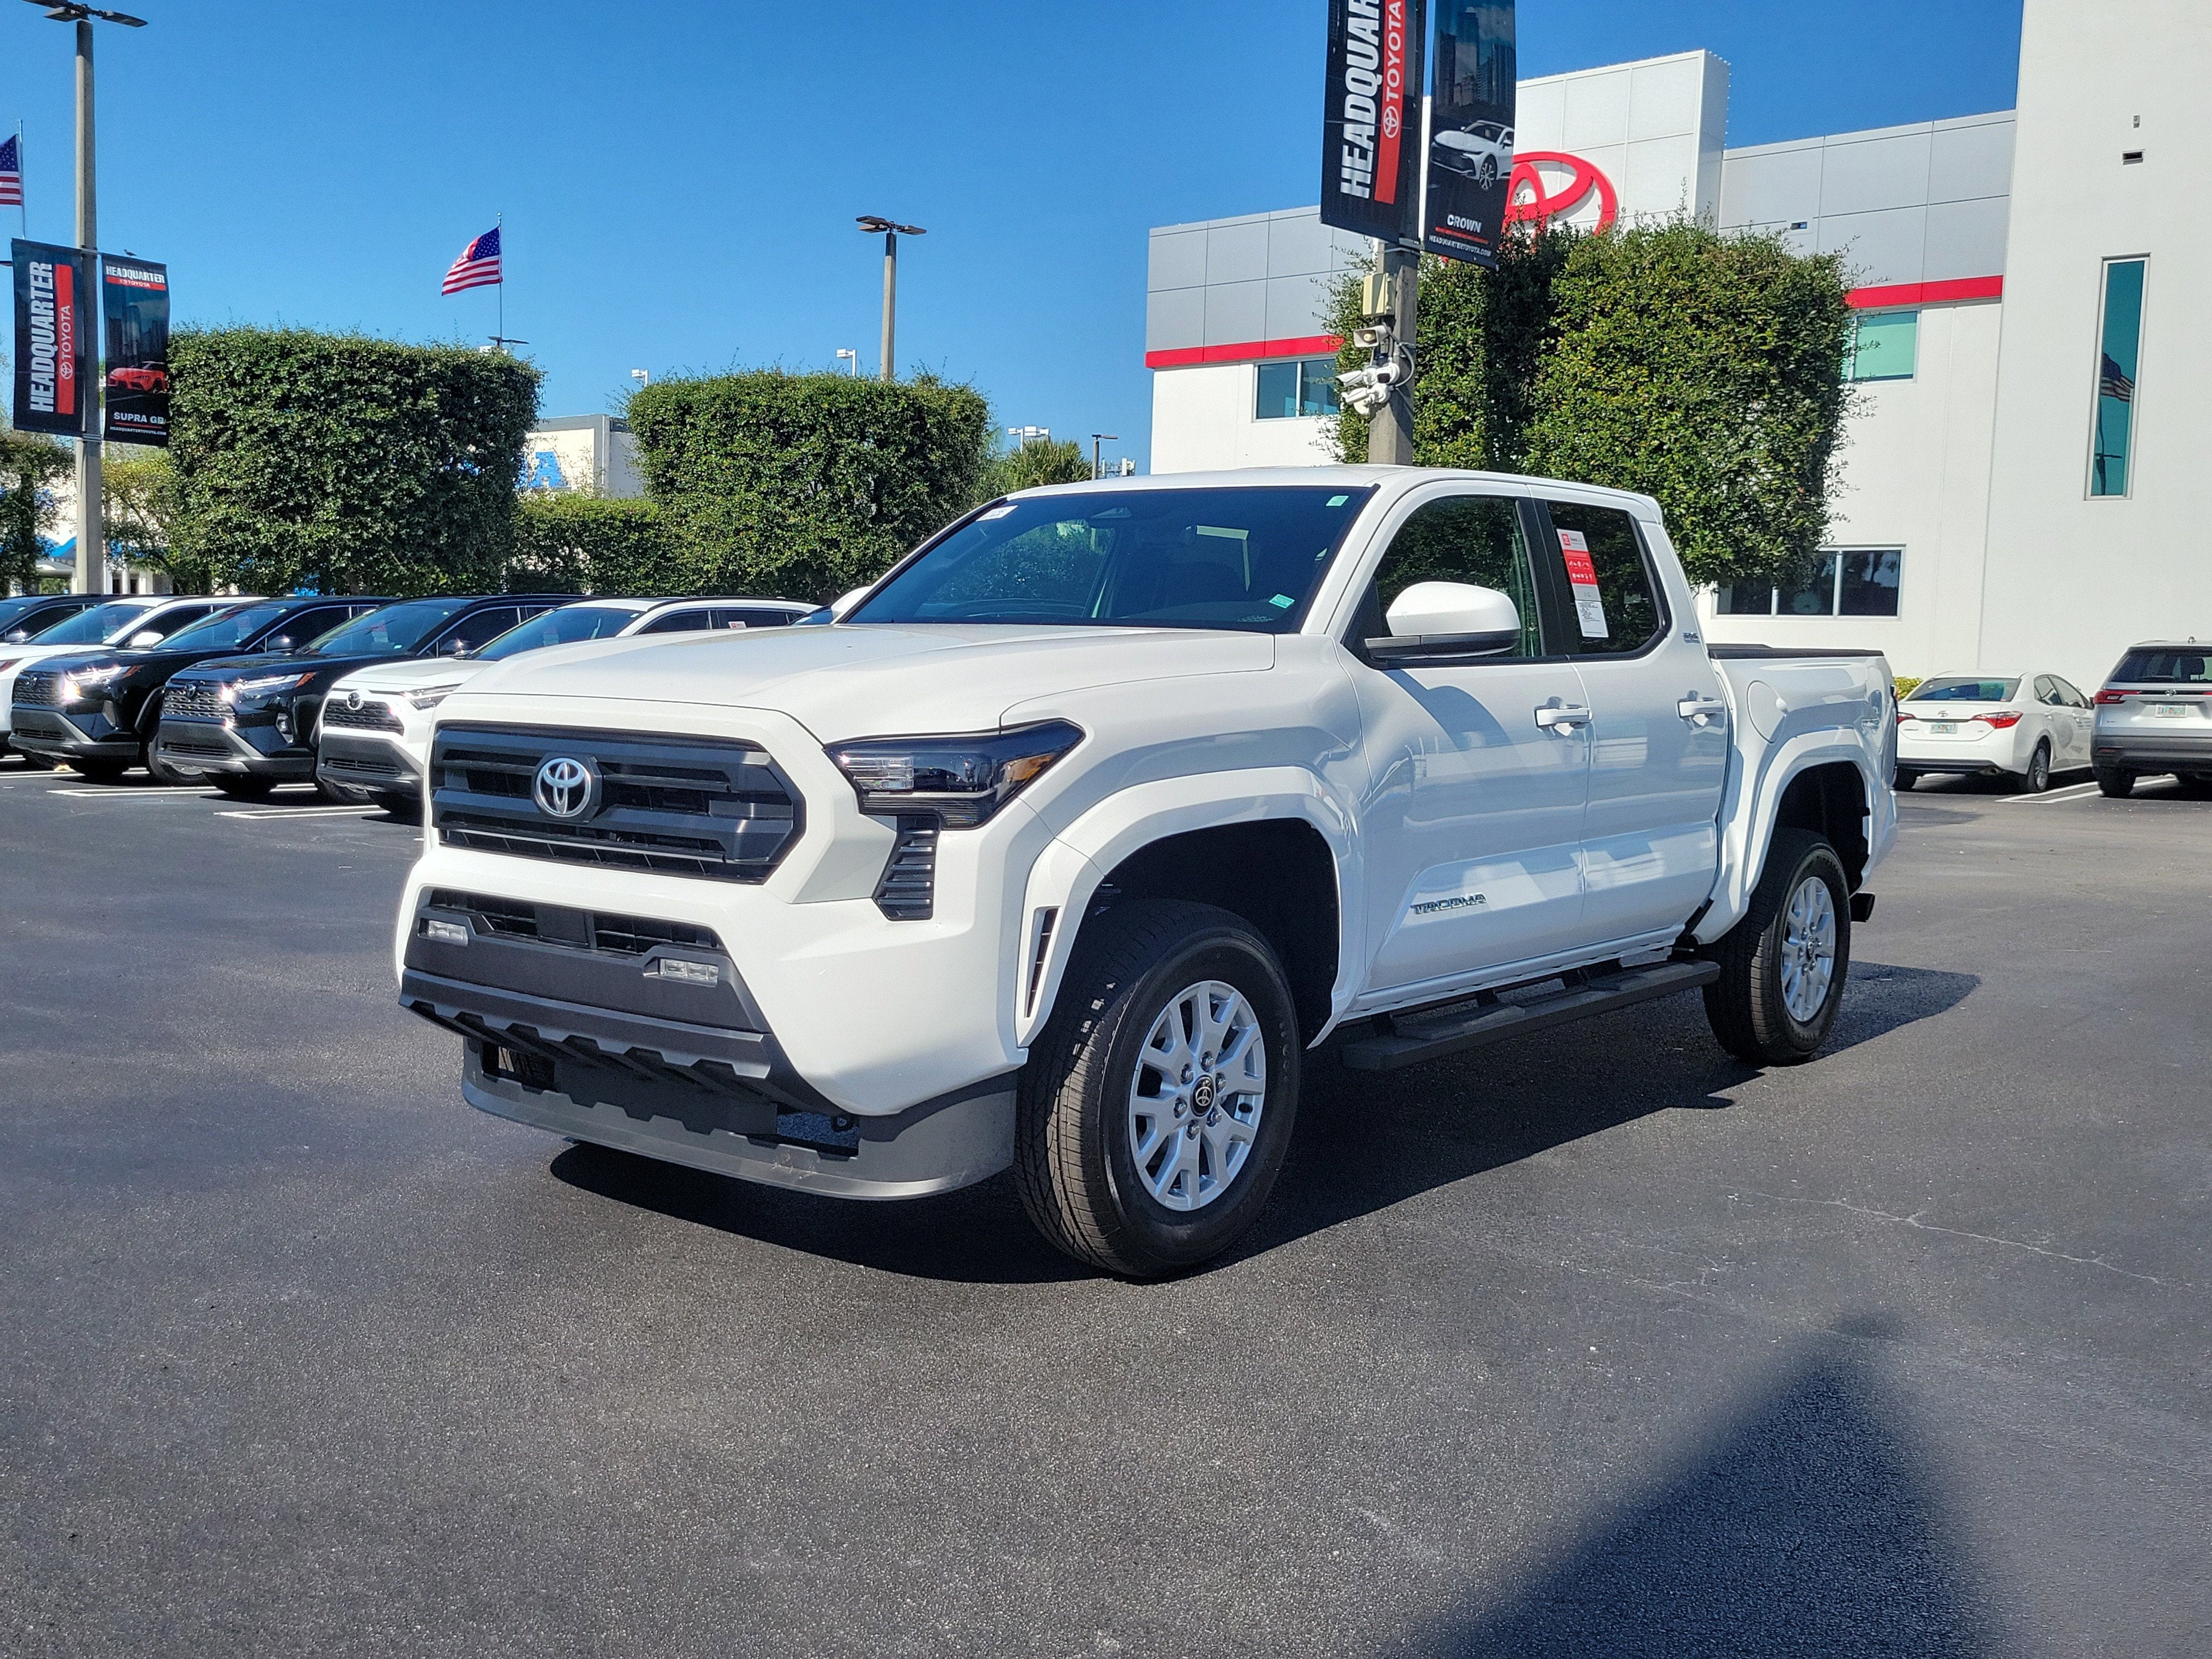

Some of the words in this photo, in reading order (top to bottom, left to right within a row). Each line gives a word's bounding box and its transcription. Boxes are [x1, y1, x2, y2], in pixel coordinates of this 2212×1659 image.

[1386, 1, 1401, 103] TOYOTA
[1447, 214, 1482, 233] CROWN
[105, 266, 165, 284] HEADQUARTER
[128, 280, 151, 288] TOYOTA
[29, 261, 59, 413] HEADQUARTER
[61, 305, 72, 360] TOYOTA
[113, 411, 148, 423] SUPRA
[1410, 892, 1487, 915] TACOMA
